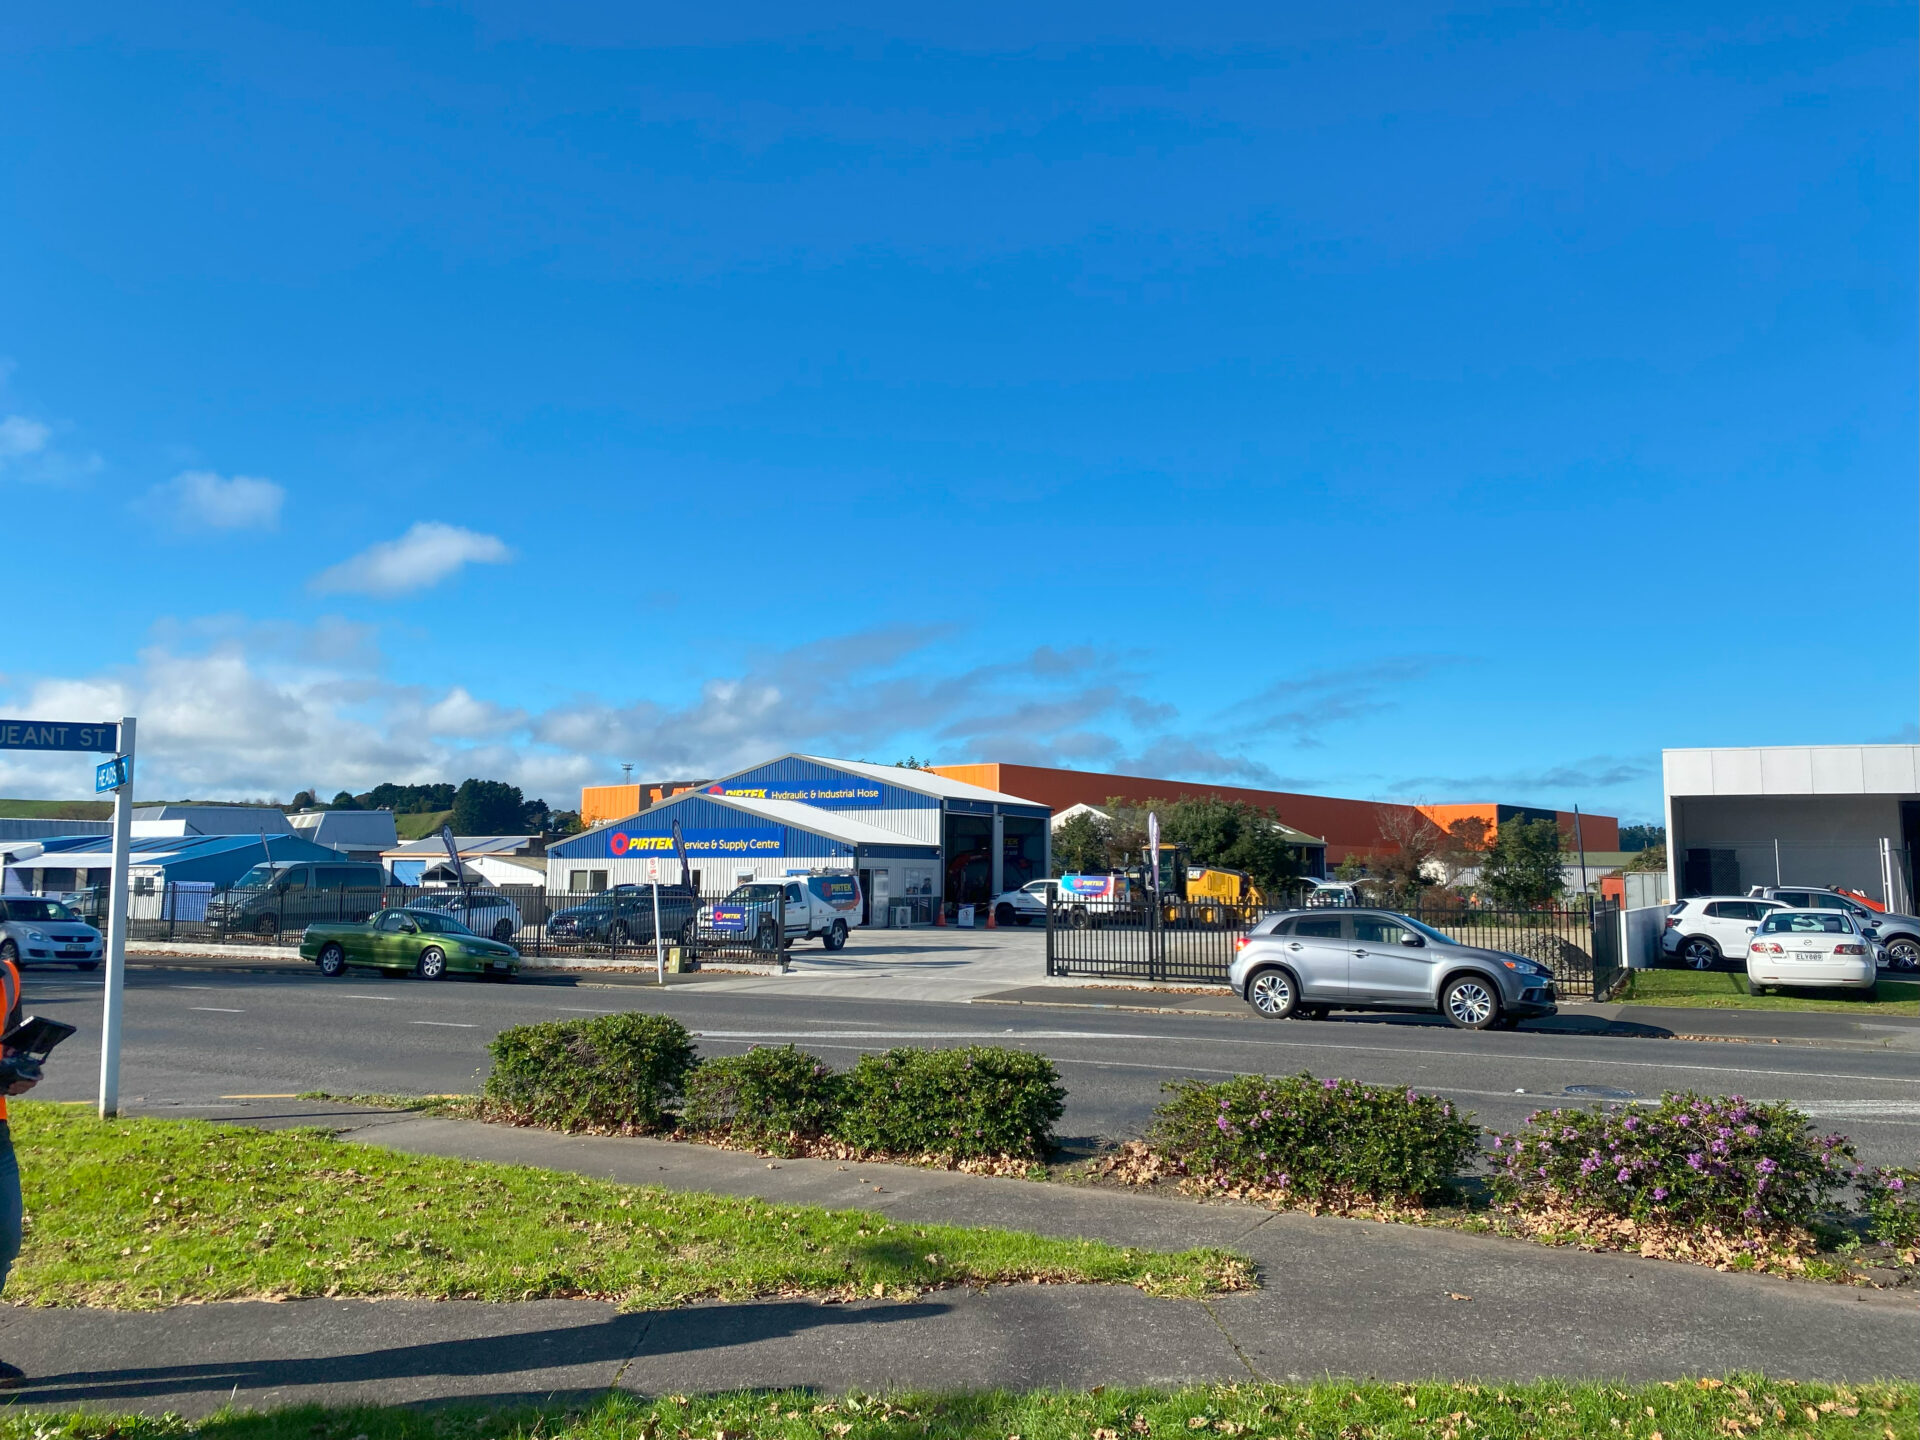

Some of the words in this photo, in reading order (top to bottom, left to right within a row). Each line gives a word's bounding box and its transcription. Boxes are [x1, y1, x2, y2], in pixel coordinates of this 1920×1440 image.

[80, 728, 106, 747] ST
[771, 790, 807, 800] Hydraulic
[810, 790, 816, 799] &
[818, 789, 855, 798] Industrial
[857, 788, 879, 798] Hose
[628, 837, 674, 850] PIRTEK
[684, 841, 710, 850] ervice
[711, 840, 717, 849] &
[719, 839, 748, 852] Supply
[750, 839, 779, 850] Centre
[1188, 870, 1201, 880] CAT
